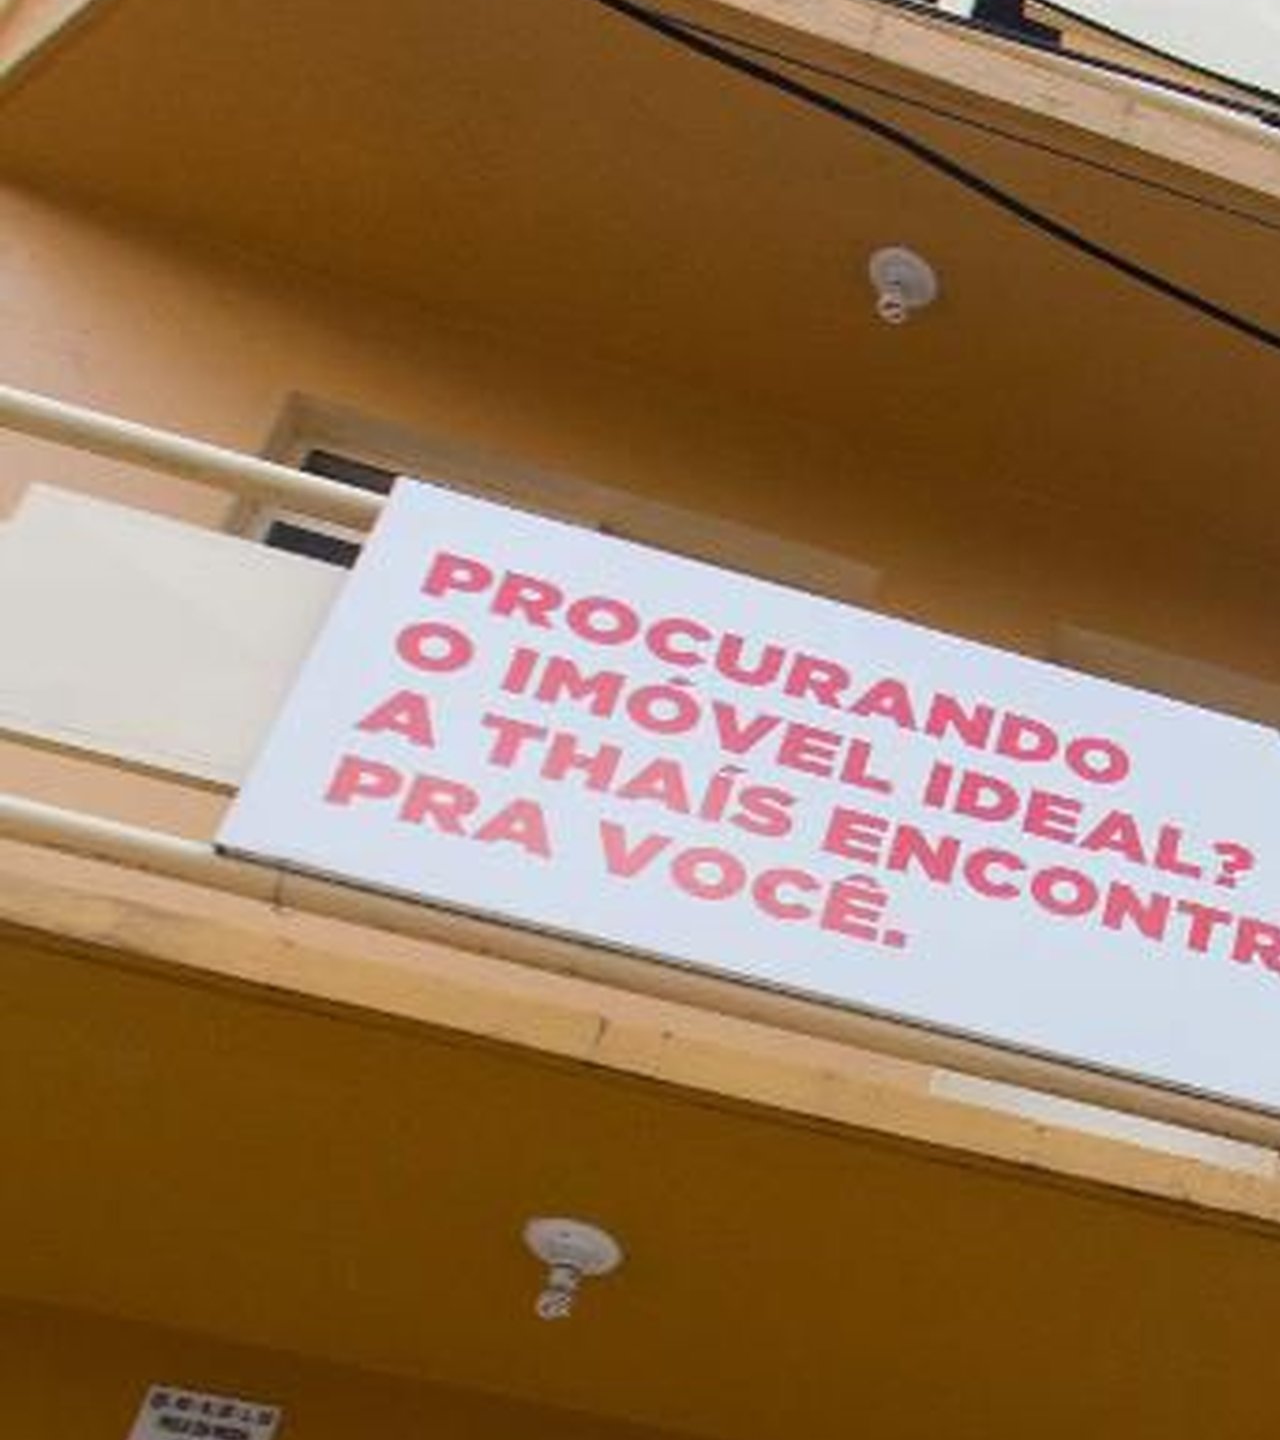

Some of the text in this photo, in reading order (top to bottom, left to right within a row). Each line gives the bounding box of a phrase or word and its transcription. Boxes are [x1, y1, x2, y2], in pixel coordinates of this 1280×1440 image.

[356, 690, 434, 748] A
[482, 715, 792, 838] THAÍS
[398, 622, 1254, 887] O IMÓVEL IDEAL?
[420, 552, 1132, 786] PROCURANDO
[324, 753, 907, 949] PRA VOCÊ.
